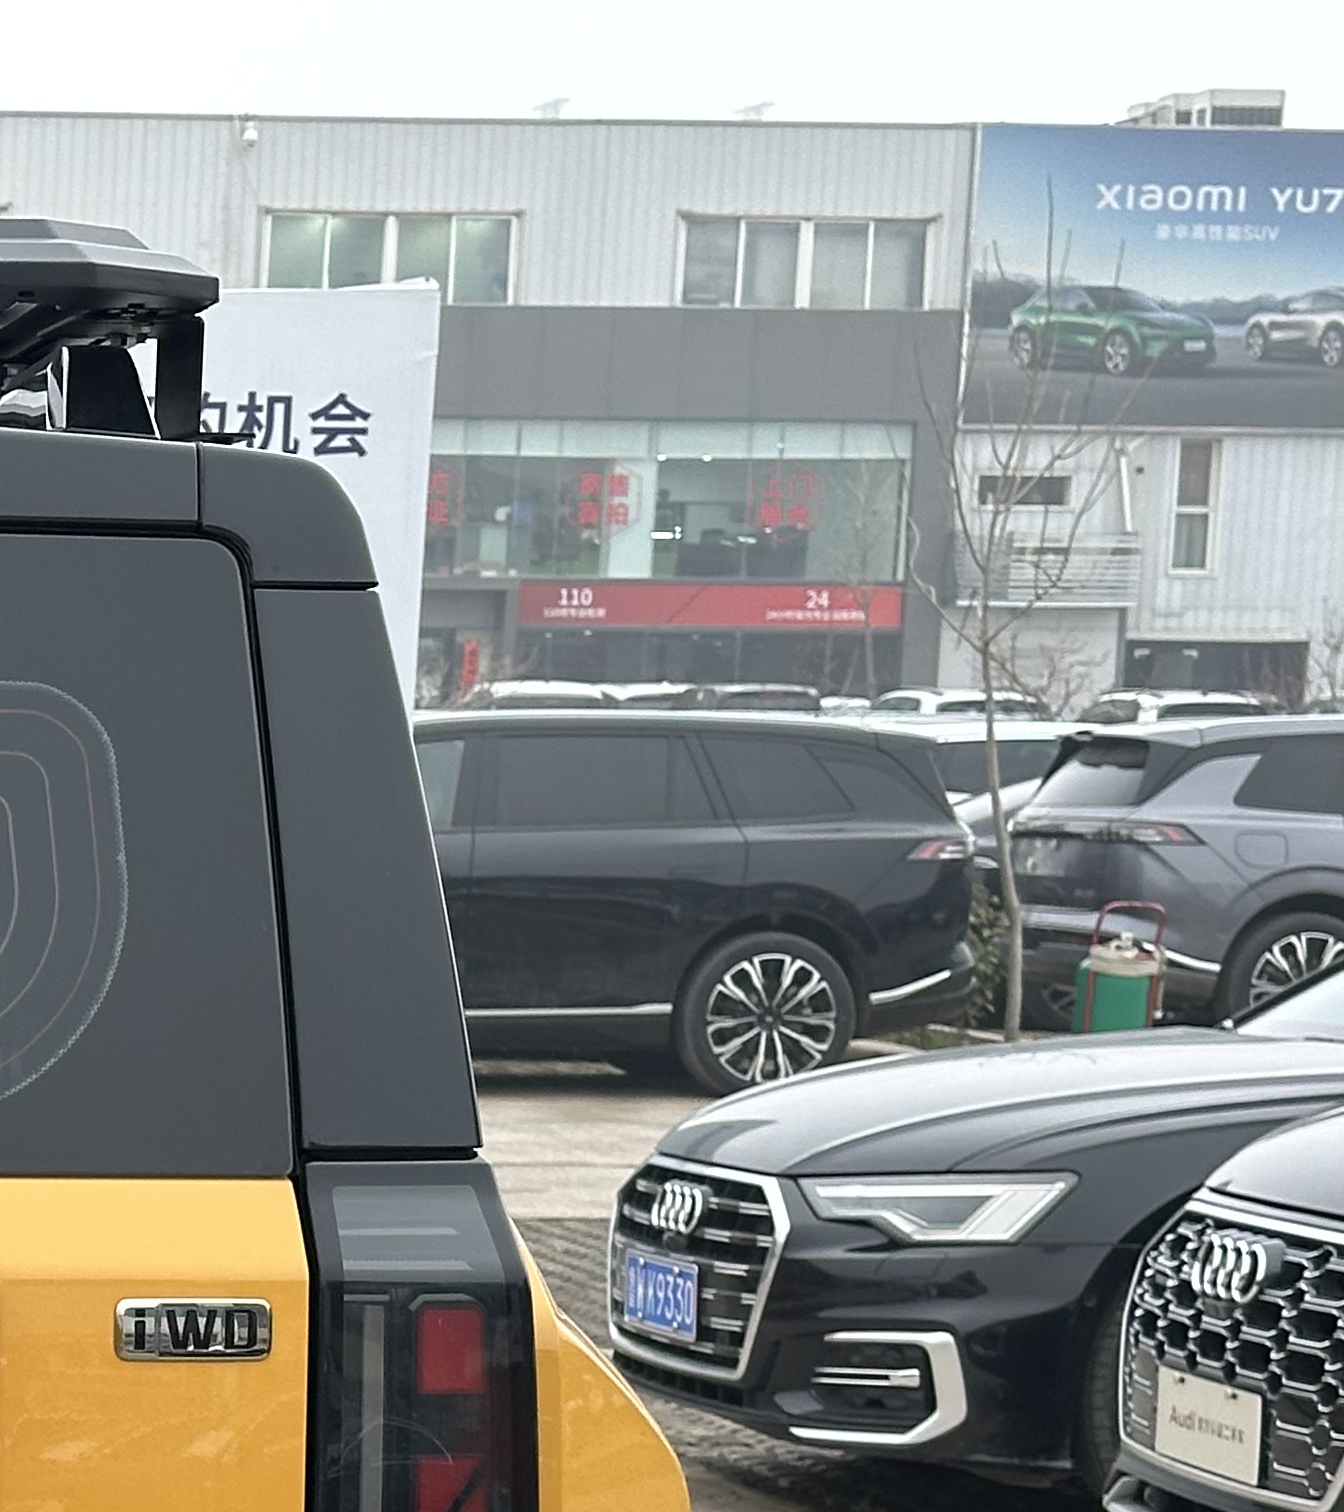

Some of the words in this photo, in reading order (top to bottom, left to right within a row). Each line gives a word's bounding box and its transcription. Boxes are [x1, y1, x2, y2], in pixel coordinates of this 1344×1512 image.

[1269, 186, 1344, 214] YU7
[558, 587, 593, 606] 110
[805, 589, 830, 609] 24
